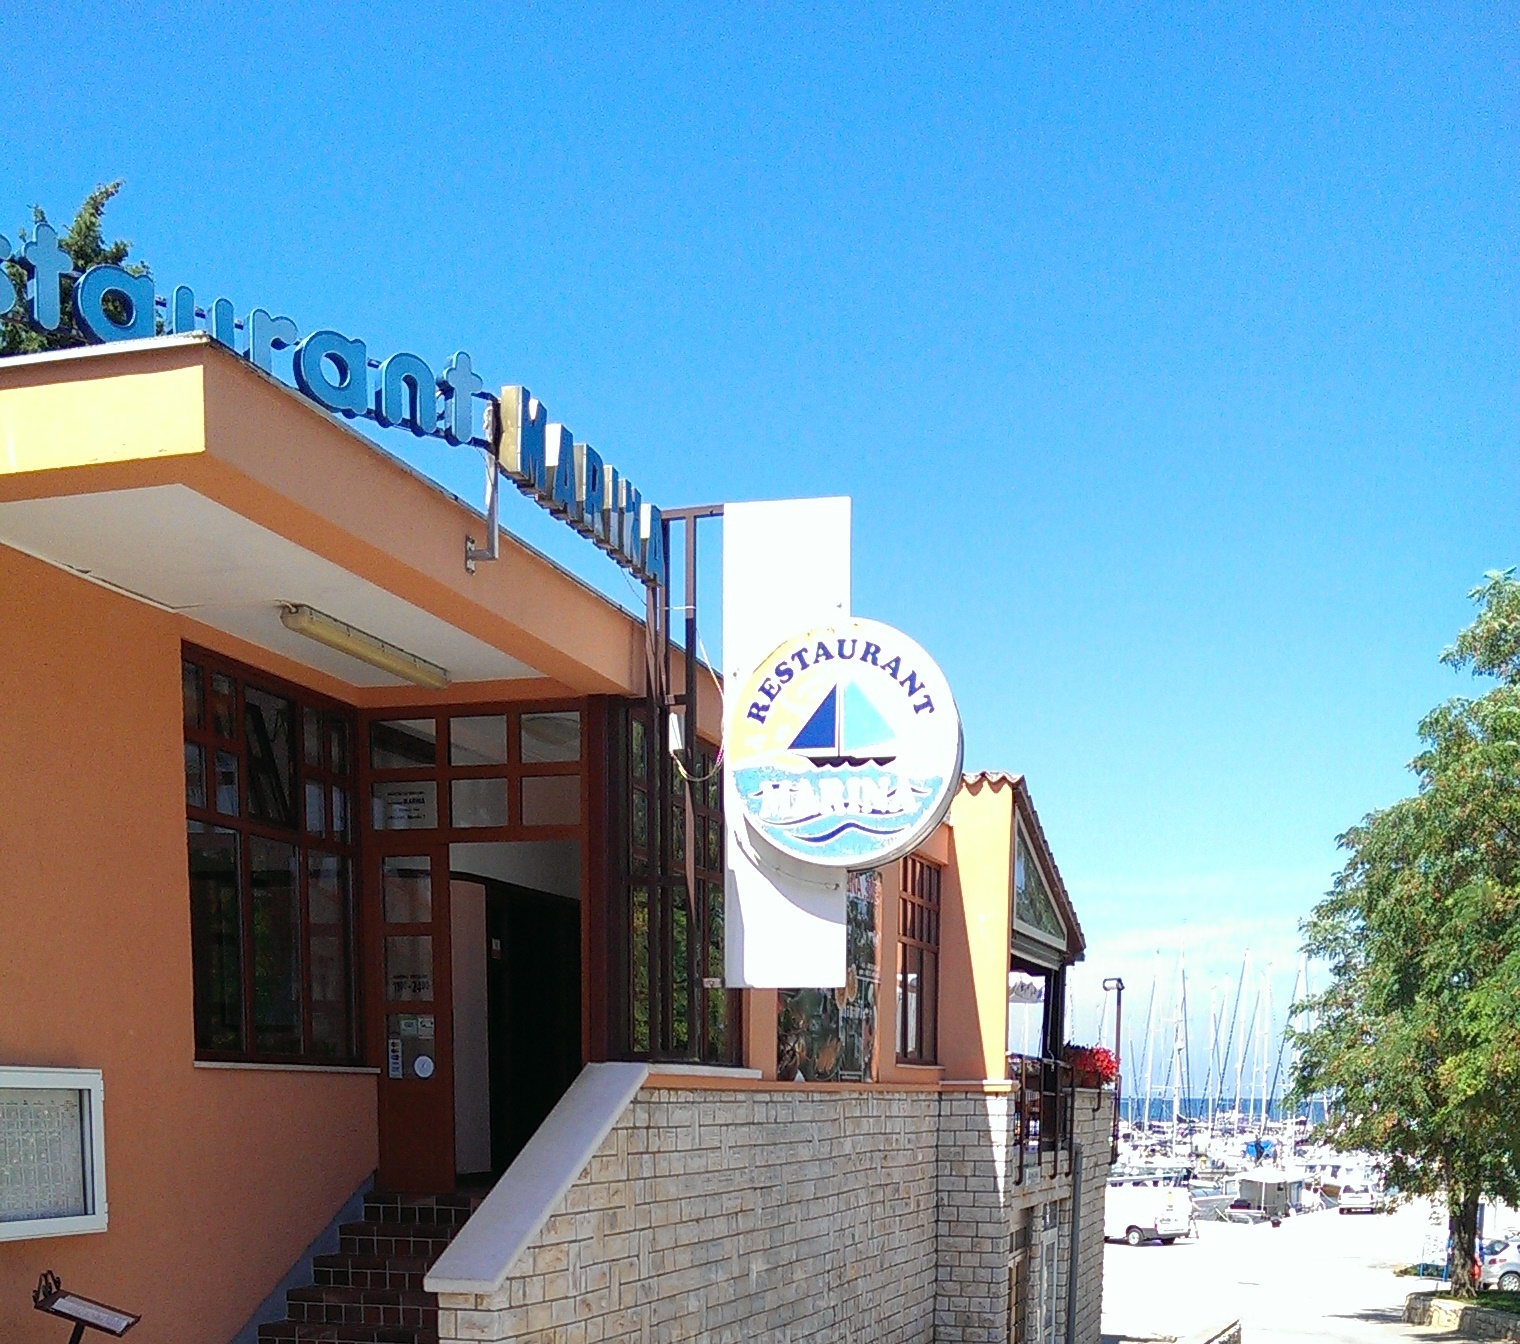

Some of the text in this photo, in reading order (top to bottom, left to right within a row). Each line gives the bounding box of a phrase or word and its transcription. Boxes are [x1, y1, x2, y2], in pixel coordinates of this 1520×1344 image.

[499, 385, 665, 588] MARINA
[746, 638, 936, 725] RESTAURANT
[757, 775, 924, 823] MARINA
